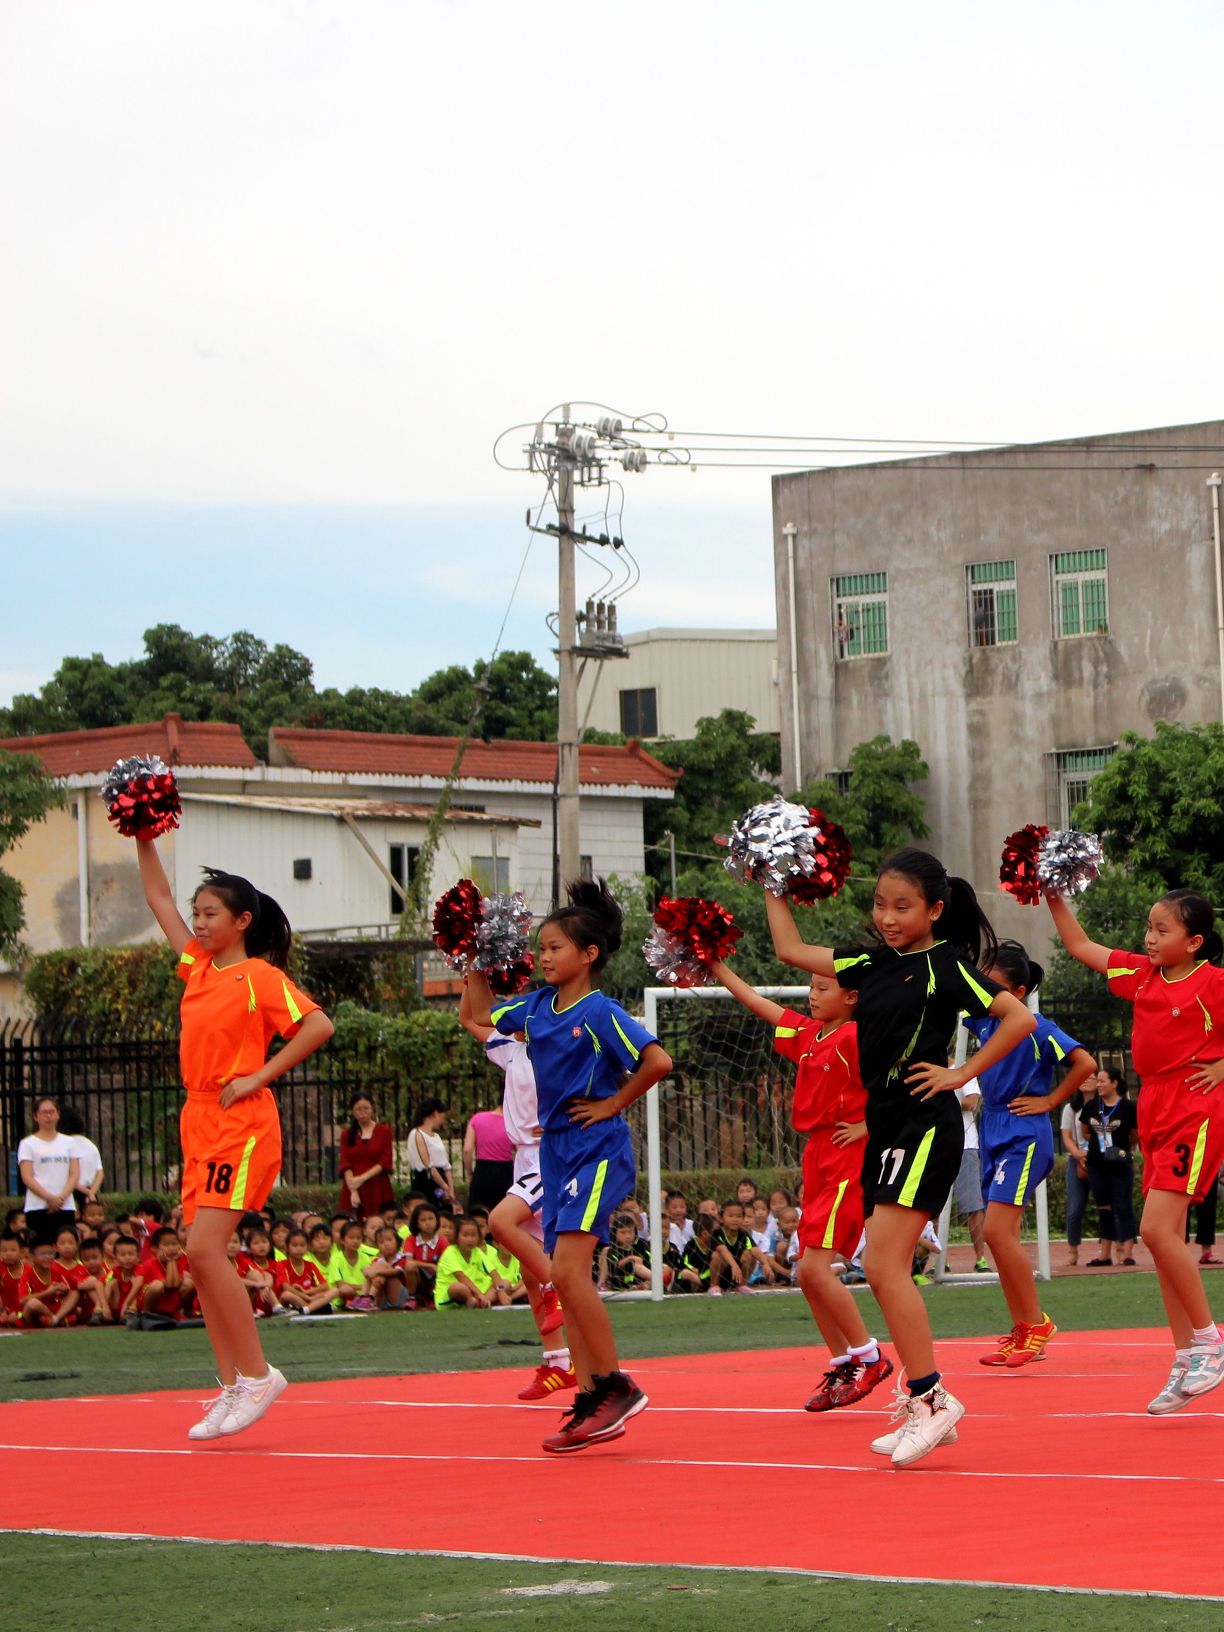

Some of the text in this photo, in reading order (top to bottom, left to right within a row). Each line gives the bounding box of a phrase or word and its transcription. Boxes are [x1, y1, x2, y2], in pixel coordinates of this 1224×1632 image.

[878, 1147, 906, 1185] 11
[1173, 1143, 1190, 1177] 3
[205, 1161, 233, 1194] 18
